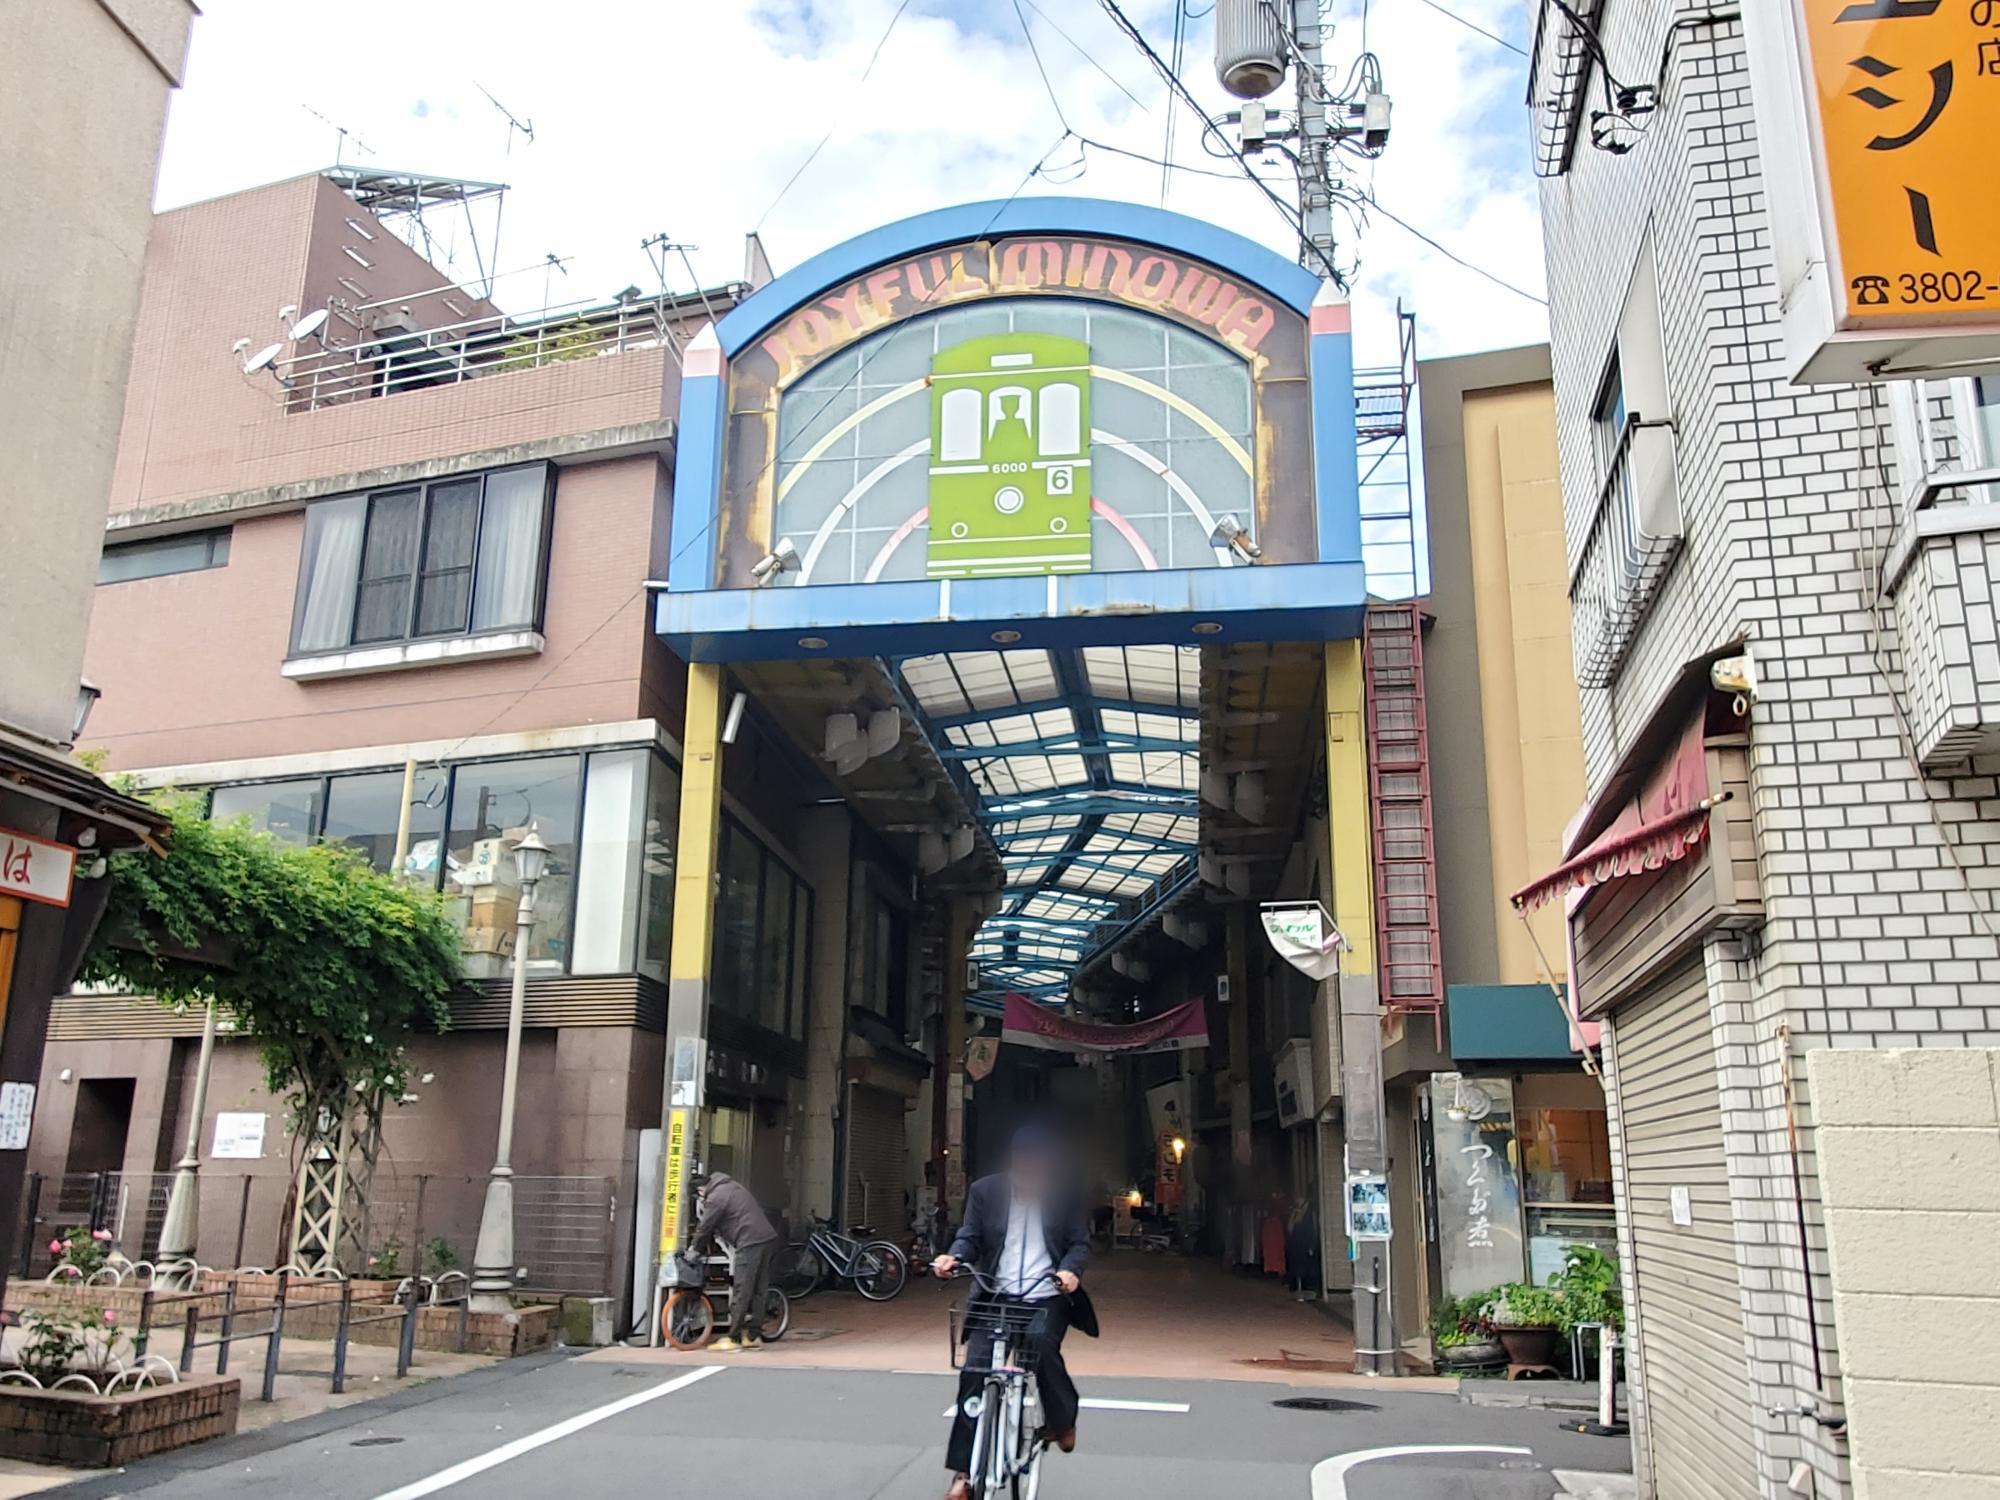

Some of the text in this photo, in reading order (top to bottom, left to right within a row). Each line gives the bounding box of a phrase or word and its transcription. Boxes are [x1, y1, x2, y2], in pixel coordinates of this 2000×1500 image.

[762, 243, 1276, 374] JOYFUL MINOWA
[992, 462, 1027, 474] 6000
[1052, 469, 1069, 490] 6
